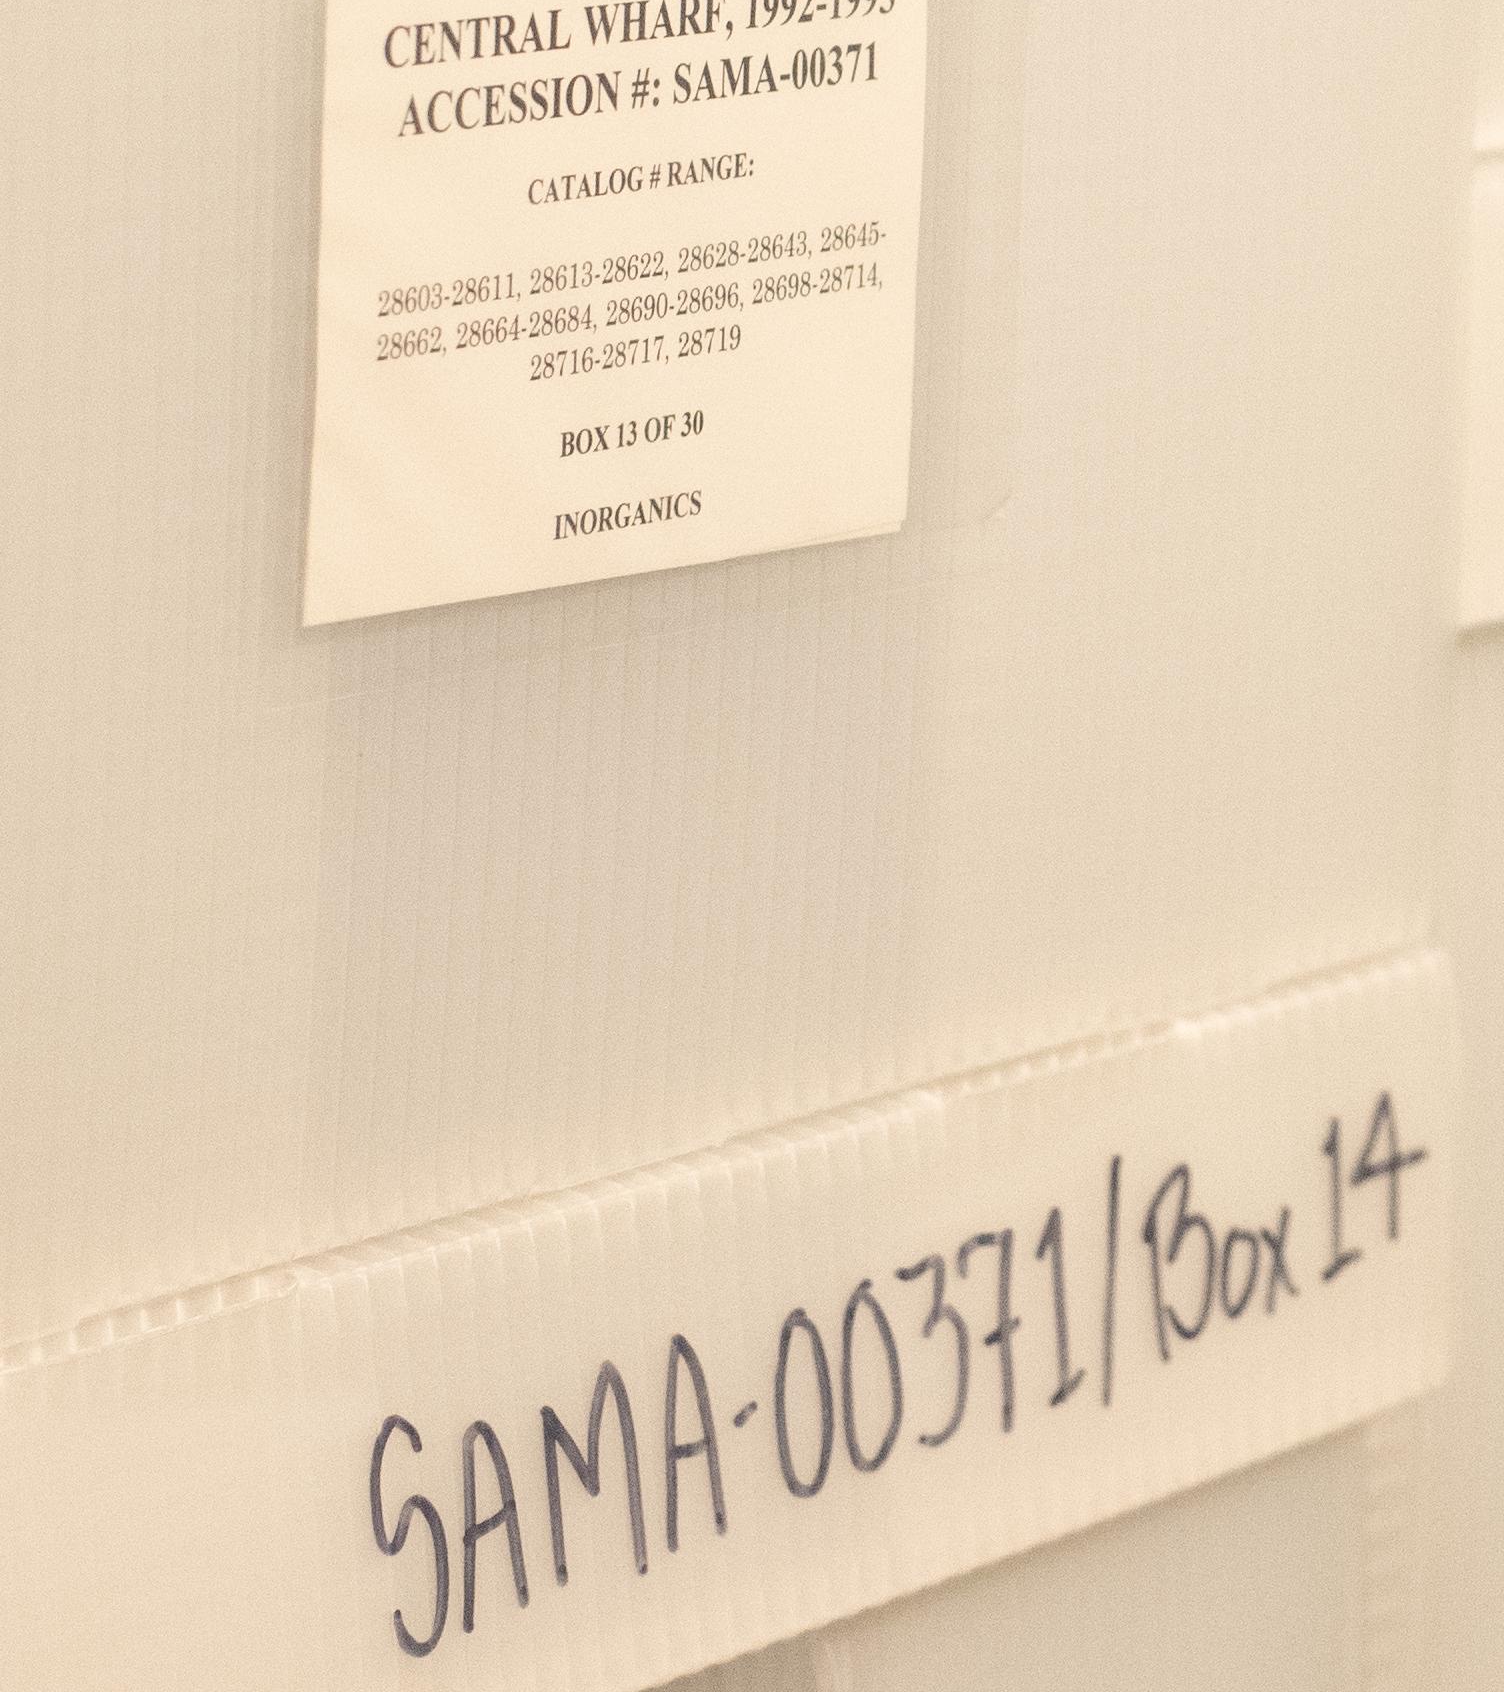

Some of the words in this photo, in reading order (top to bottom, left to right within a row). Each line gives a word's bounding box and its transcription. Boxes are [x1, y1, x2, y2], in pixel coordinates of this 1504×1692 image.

[384, 9, 570, 68] CENTRAL
[398, 70, 621, 136] ACCESSION
[630, 68, 663, 110] #:
[674, 43, 879, 102] SAMA-00371
[528, 167, 643, 204] CATALOG
[647, 164, 663, 189] #
[667, 152, 754, 188] RANGE:
[378, 273, 521, 318] 28603-28611,
[530, 252, 670, 296] 28613-28622,
[678, 232, 813, 274] 28628-28643,
[820, 221, 887, 253] 28645-
[377, 327, 447, 362] 28662,
[456, 306, 599, 349] 28664-28684,
[606, 285, 744, 327] 28690-28696,
[752, 264, 883, 305] 28698-28714,
[530, 335, 670, 382] 28716-28717,
[678, 325, 741, 358] 28719
[561, 426, 609, 457] BOX
[616, 420, 638, 448] 13
[644, 414, 675, 442] OF
[680, 410, 704, 437] 30
[555, 488, 704, 540] INORGANICS
[1320, 1092, 1427, 1283] 14
